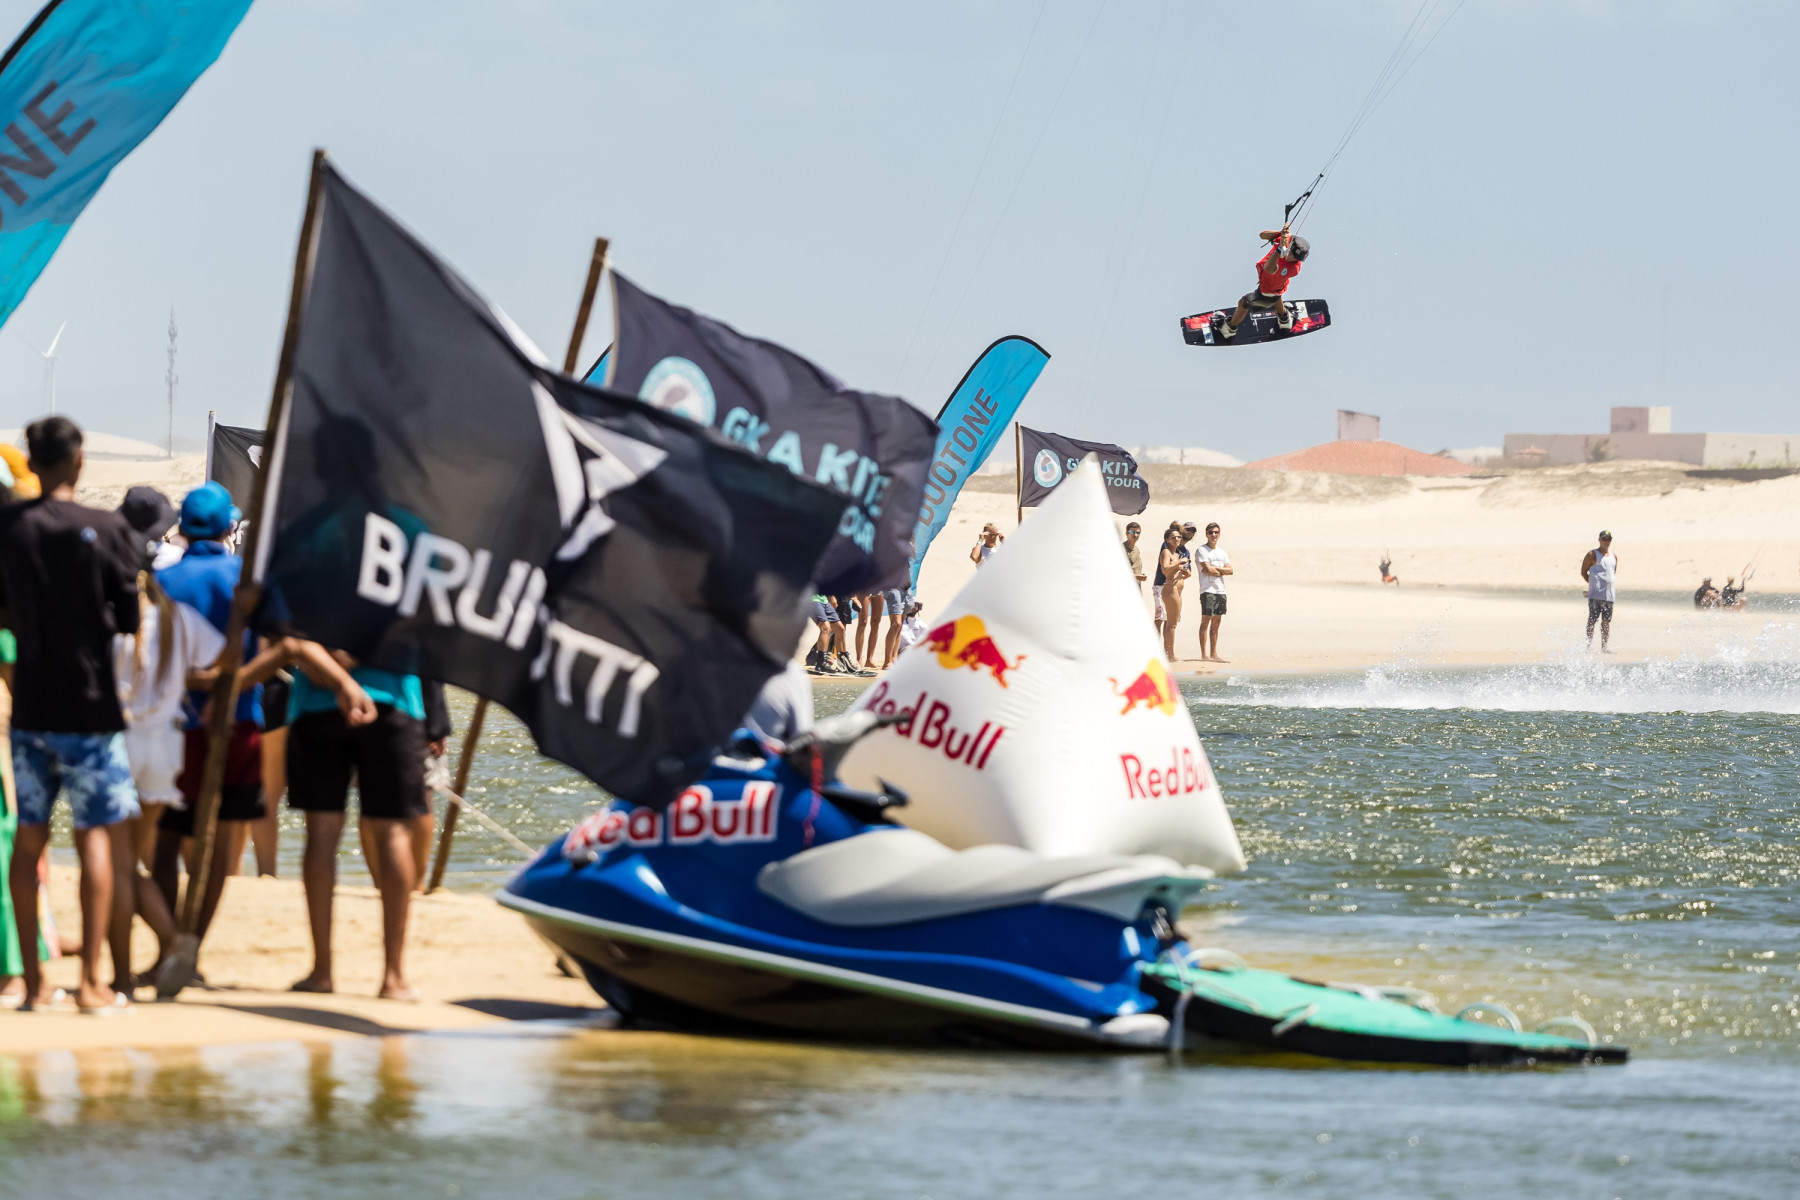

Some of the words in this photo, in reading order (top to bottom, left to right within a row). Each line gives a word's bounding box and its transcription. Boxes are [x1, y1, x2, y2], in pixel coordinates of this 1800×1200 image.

[0, 79, 98, 232] NE
[919, 387, 999, 526] DUOTONE
[1102, 460, 1128, 476] KIT
[1106, 476, 1140, 489] TOUR
[865, 681, 927, 738] Red
[919, 700, 1004, 769] Bull
[1120, 746, 1178, 799] Red
[670, 785, 777, 841] Bull
